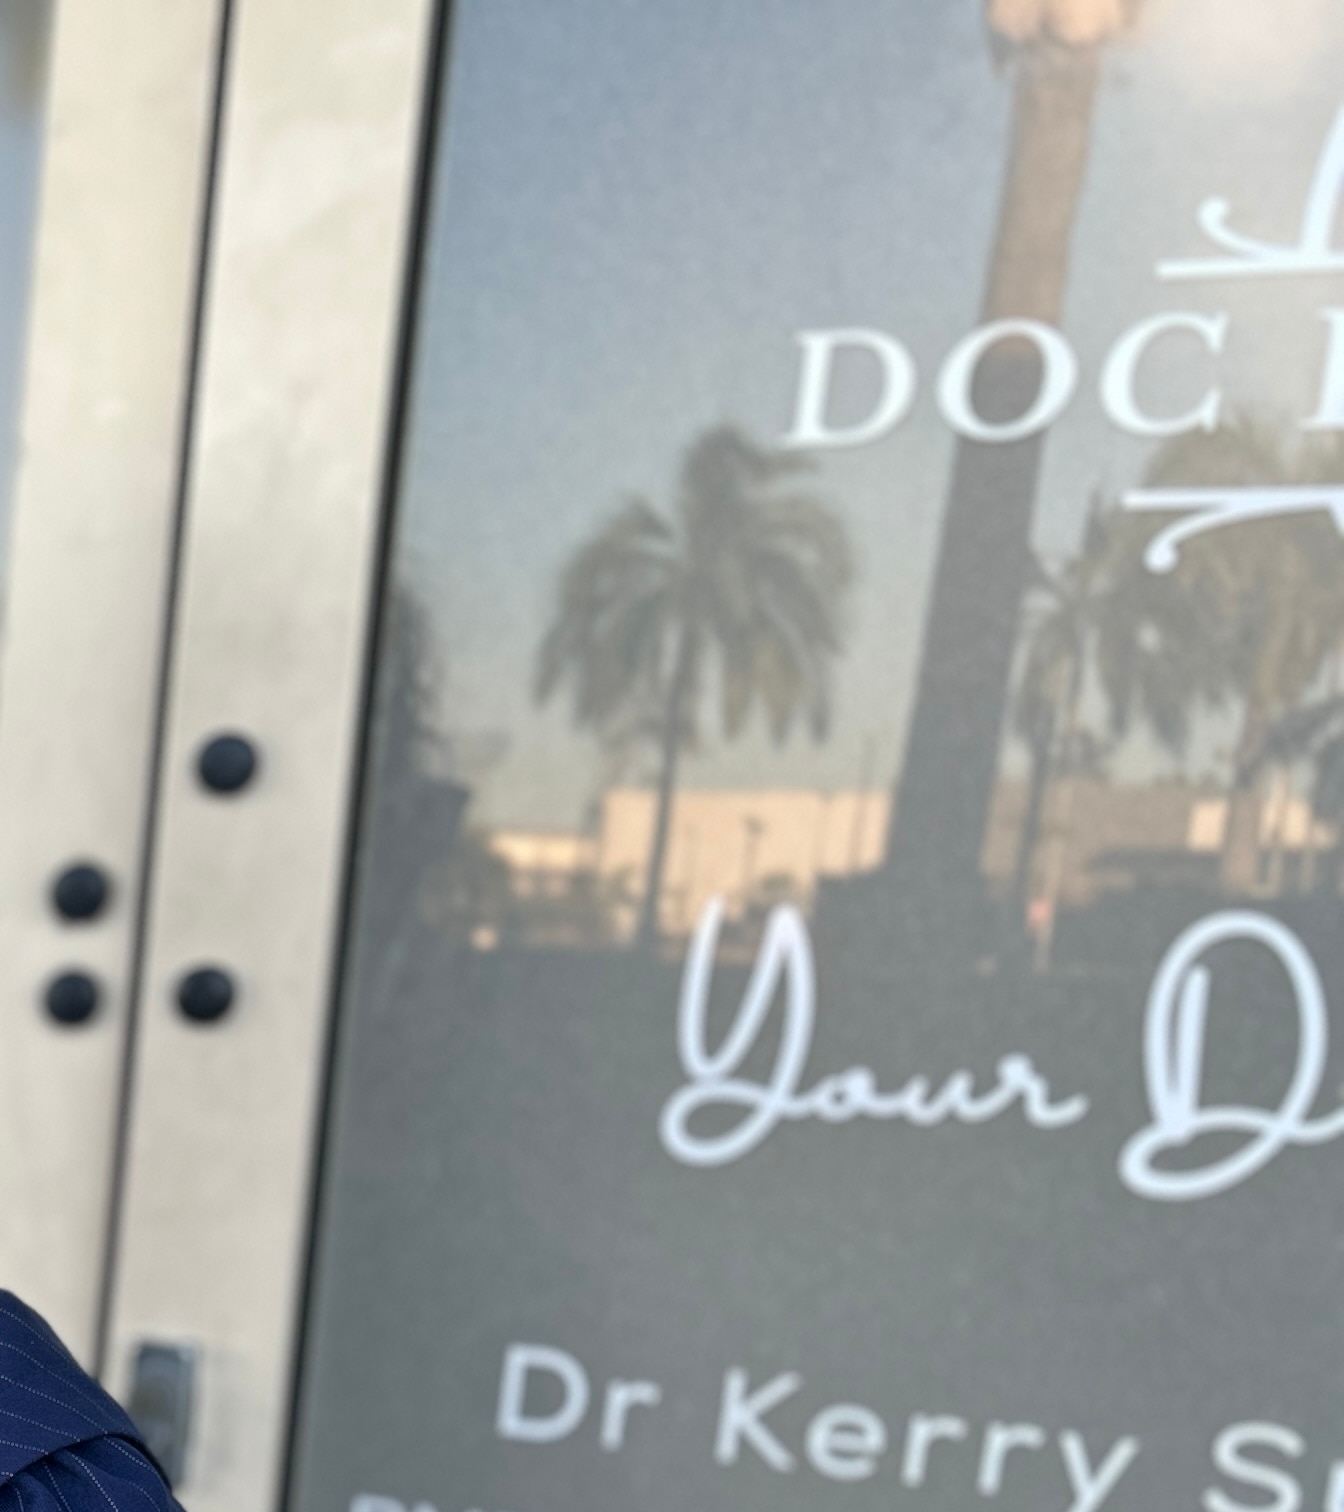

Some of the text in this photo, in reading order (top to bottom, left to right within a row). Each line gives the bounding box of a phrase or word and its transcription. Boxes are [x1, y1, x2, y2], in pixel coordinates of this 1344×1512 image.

[784, 308, 1228, 448] DOC
[659, 895, 1344, 1202] Your D
[495, 1342, 662, 1452] Dr
